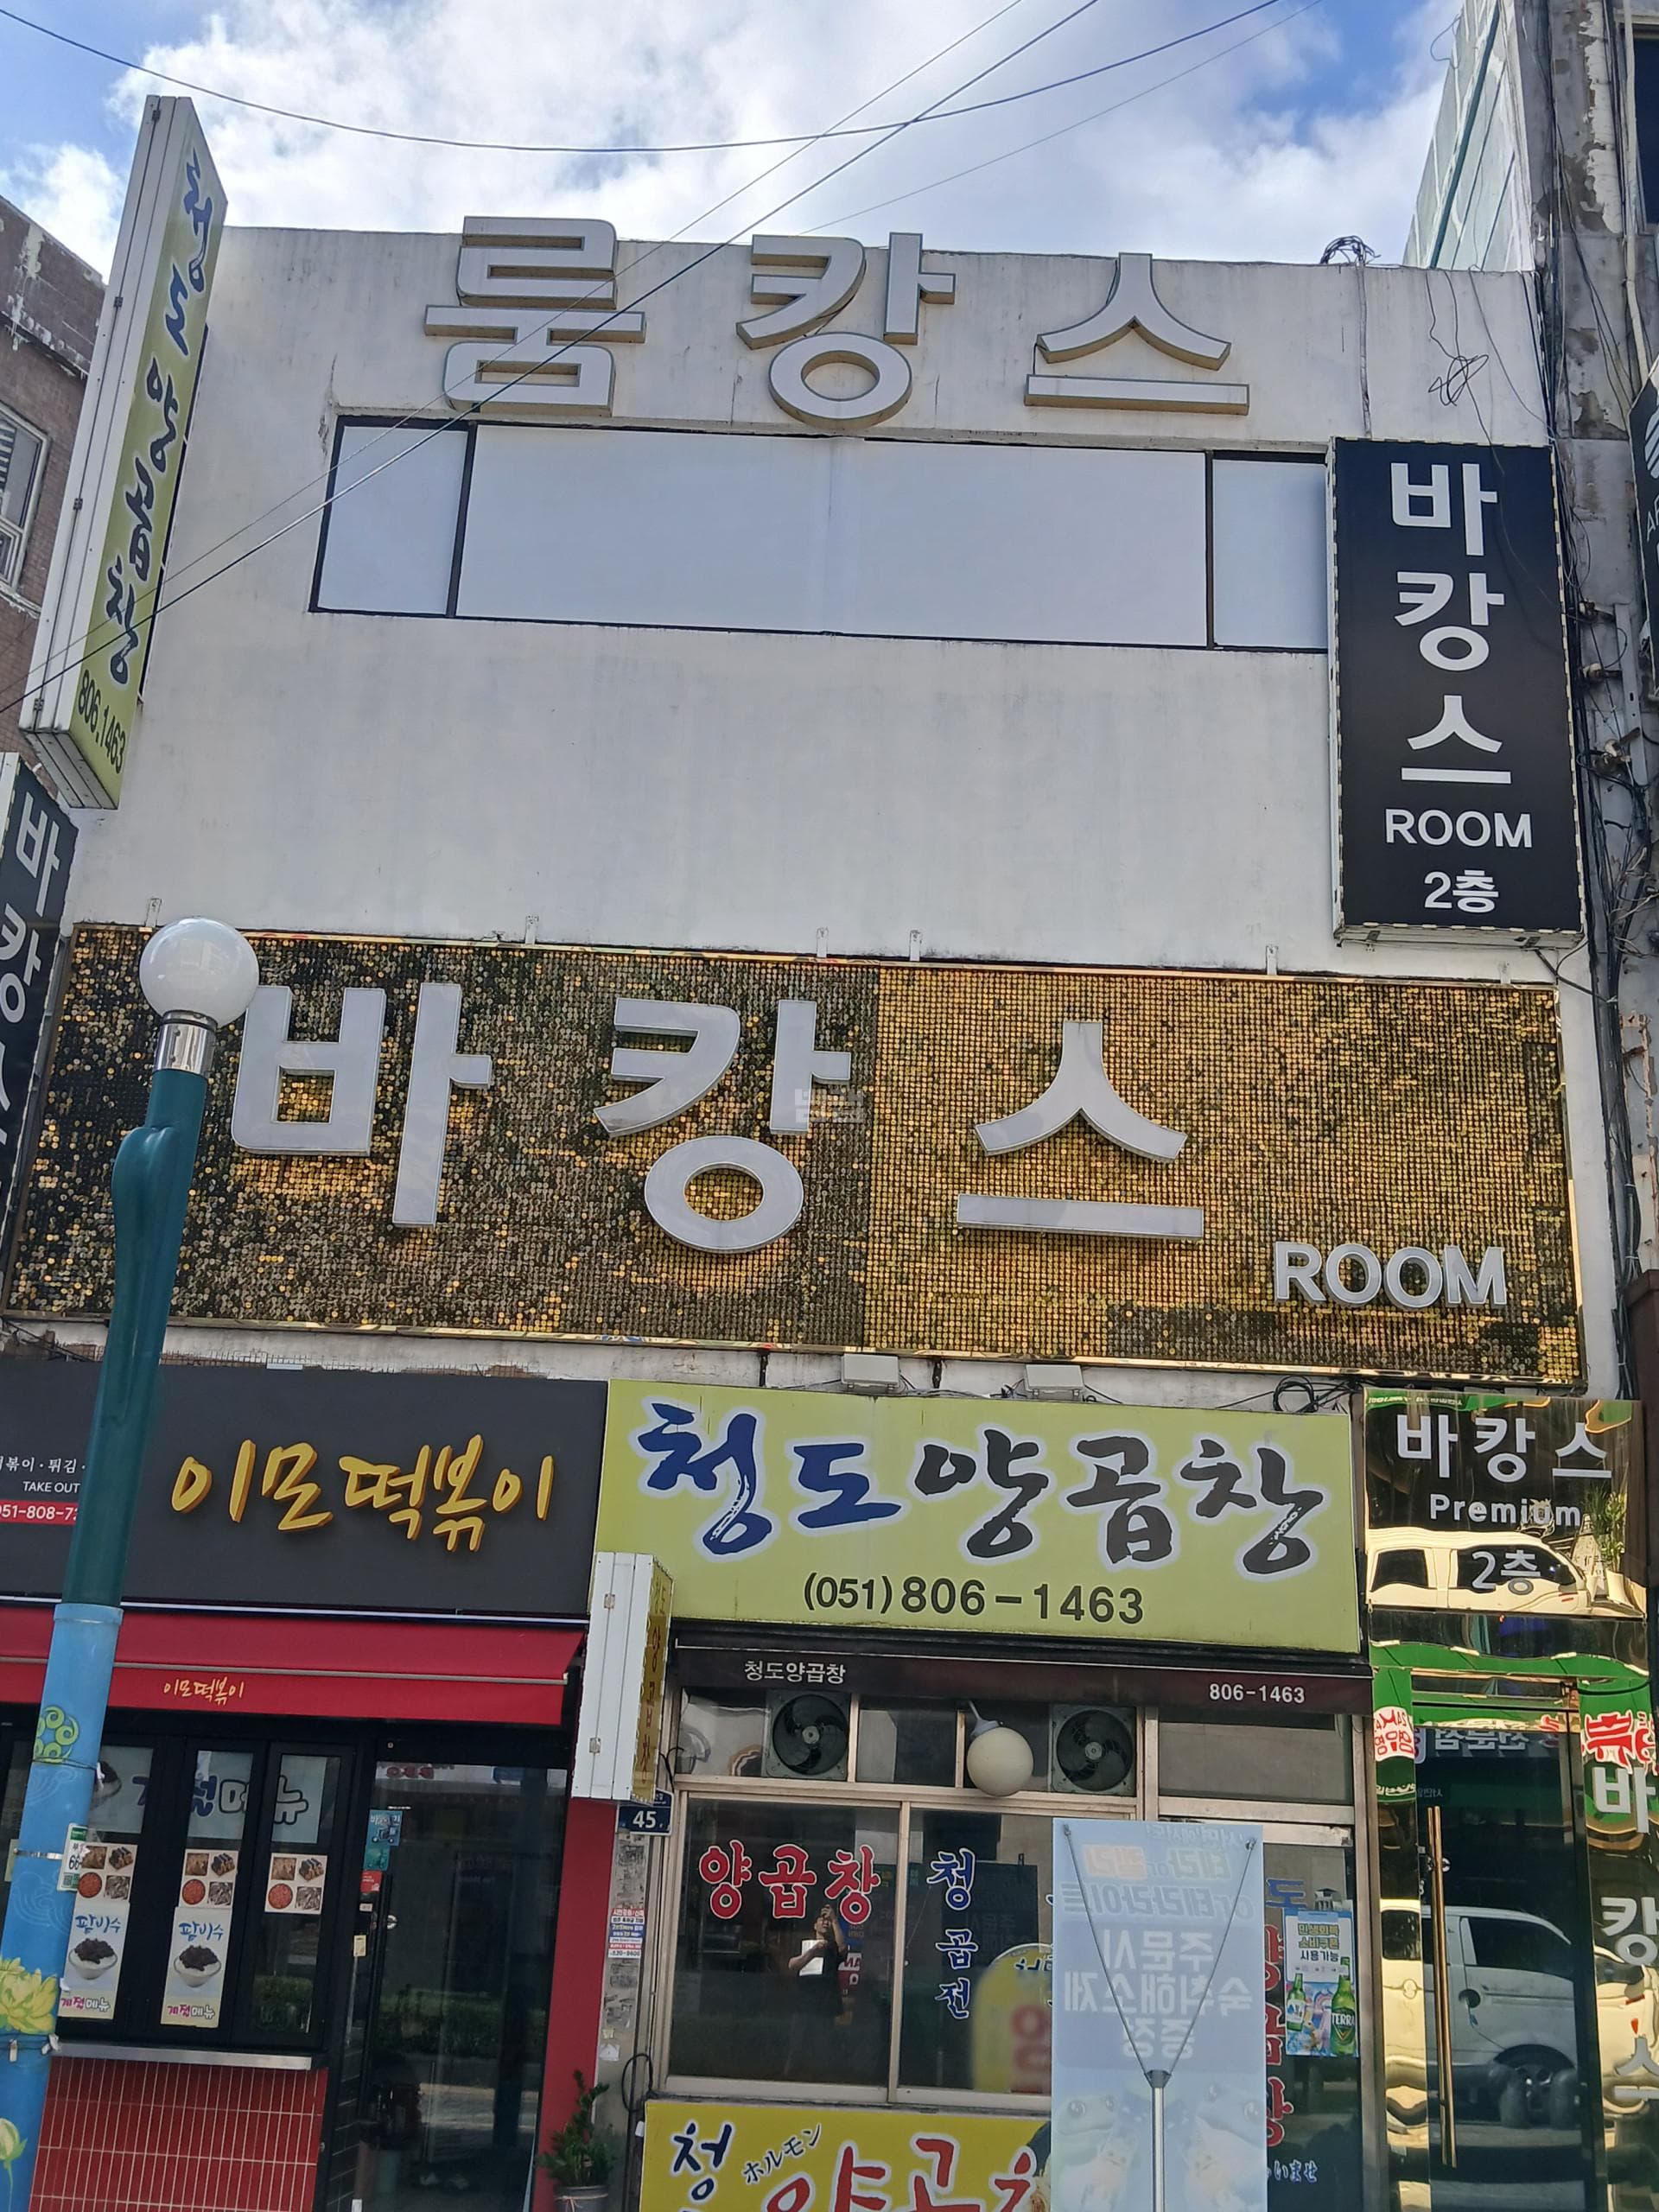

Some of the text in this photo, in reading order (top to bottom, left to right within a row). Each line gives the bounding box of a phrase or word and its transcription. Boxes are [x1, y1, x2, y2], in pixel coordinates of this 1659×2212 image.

[423, 216, 1249, 429] 룸캉스
[1390, 462, 1511, 785] 바캉스
[1385, 809, 1534, 849] ROOM
[1423, 869, 1500, 913] 2층
[0, 791, 60, 1146] 바캉
[232, 982, 1205, 1252] 바캉스
[1273, 1241, 1508, 1309] ROOM
[1396, 1414, 1613, 1484] 바캉스
[0, 1503, 79, 1522] 51-808-7
[22, 1480, 81, 1494] TAKE OUT
[171, 1434, 555, 1553] 이모떡볶이
[636, 1402, 1325, 1574] 청도양곱창
[1430, 1493, 1581, 1528] Premium
[1471, 1549, 1541, 1596] 2층
[163, 1676, 245, 1706] 이모떡볶이
[744, 1658, 846, 1686] 청도양곱창
[1209, 1682, 1306, 1706] 806-1463
[632, 1809, 657, 1828] 45
[698, 1840, 881, 1925] 양곱창
[741, 2123, 823, 2185] ホルモン
